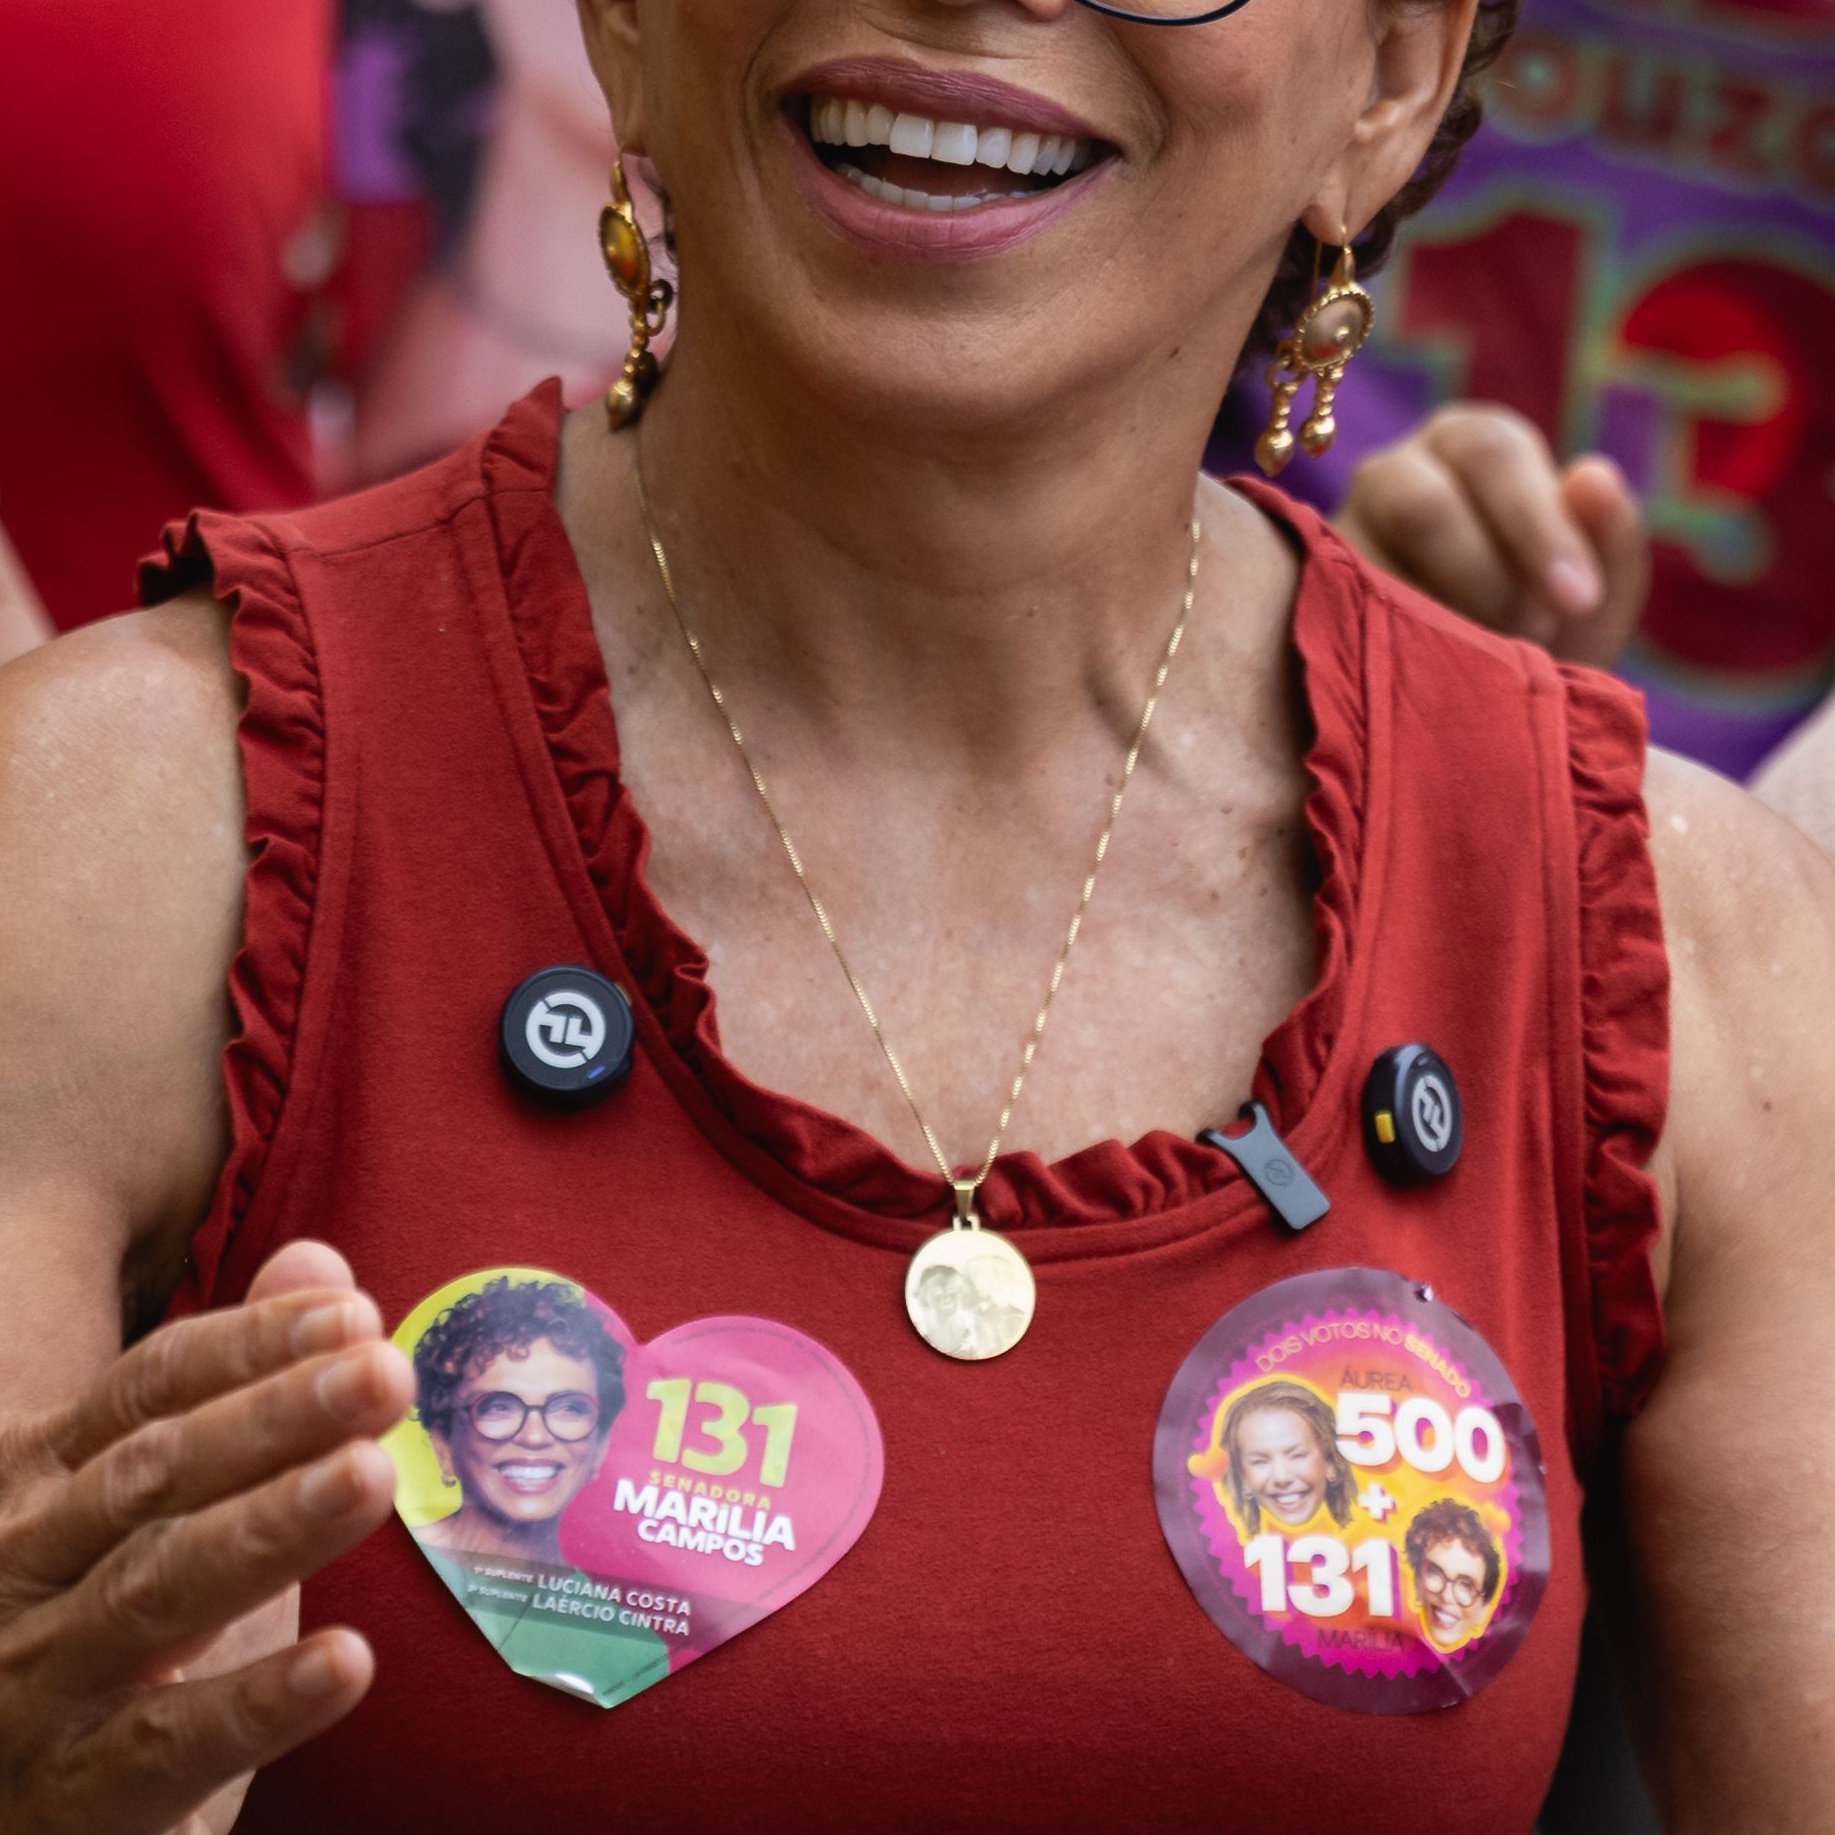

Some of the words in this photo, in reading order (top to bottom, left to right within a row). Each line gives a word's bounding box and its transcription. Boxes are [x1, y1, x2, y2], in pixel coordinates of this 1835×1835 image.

[1255, 1338, 1303, 1374] DOIS
[1304, 1322, 1370, 1349] VOTOS
[1372, 1324, 1403, 1347] NO
[1403, 1333, 1473, 1399] SENADO
[1340, 1364, 1413, 1392] ÁUREA
[645, 1377, 798, 1488] 131
[1334, 1392, 1508, 1484] 500
[648, 1469, 772, 1510] SENADORA
[637, 1517, 765, 1566] CAMPOS
[536, 1573, 623, 1603] LUCIANA
[625, 1590, 692, 1617] COSTA
[1244, 1533, 1399, 1619] 131
[531, 1592, 616, 1622] LAÉRCIO
[618, 1610, 691, 1637] CINTRA
